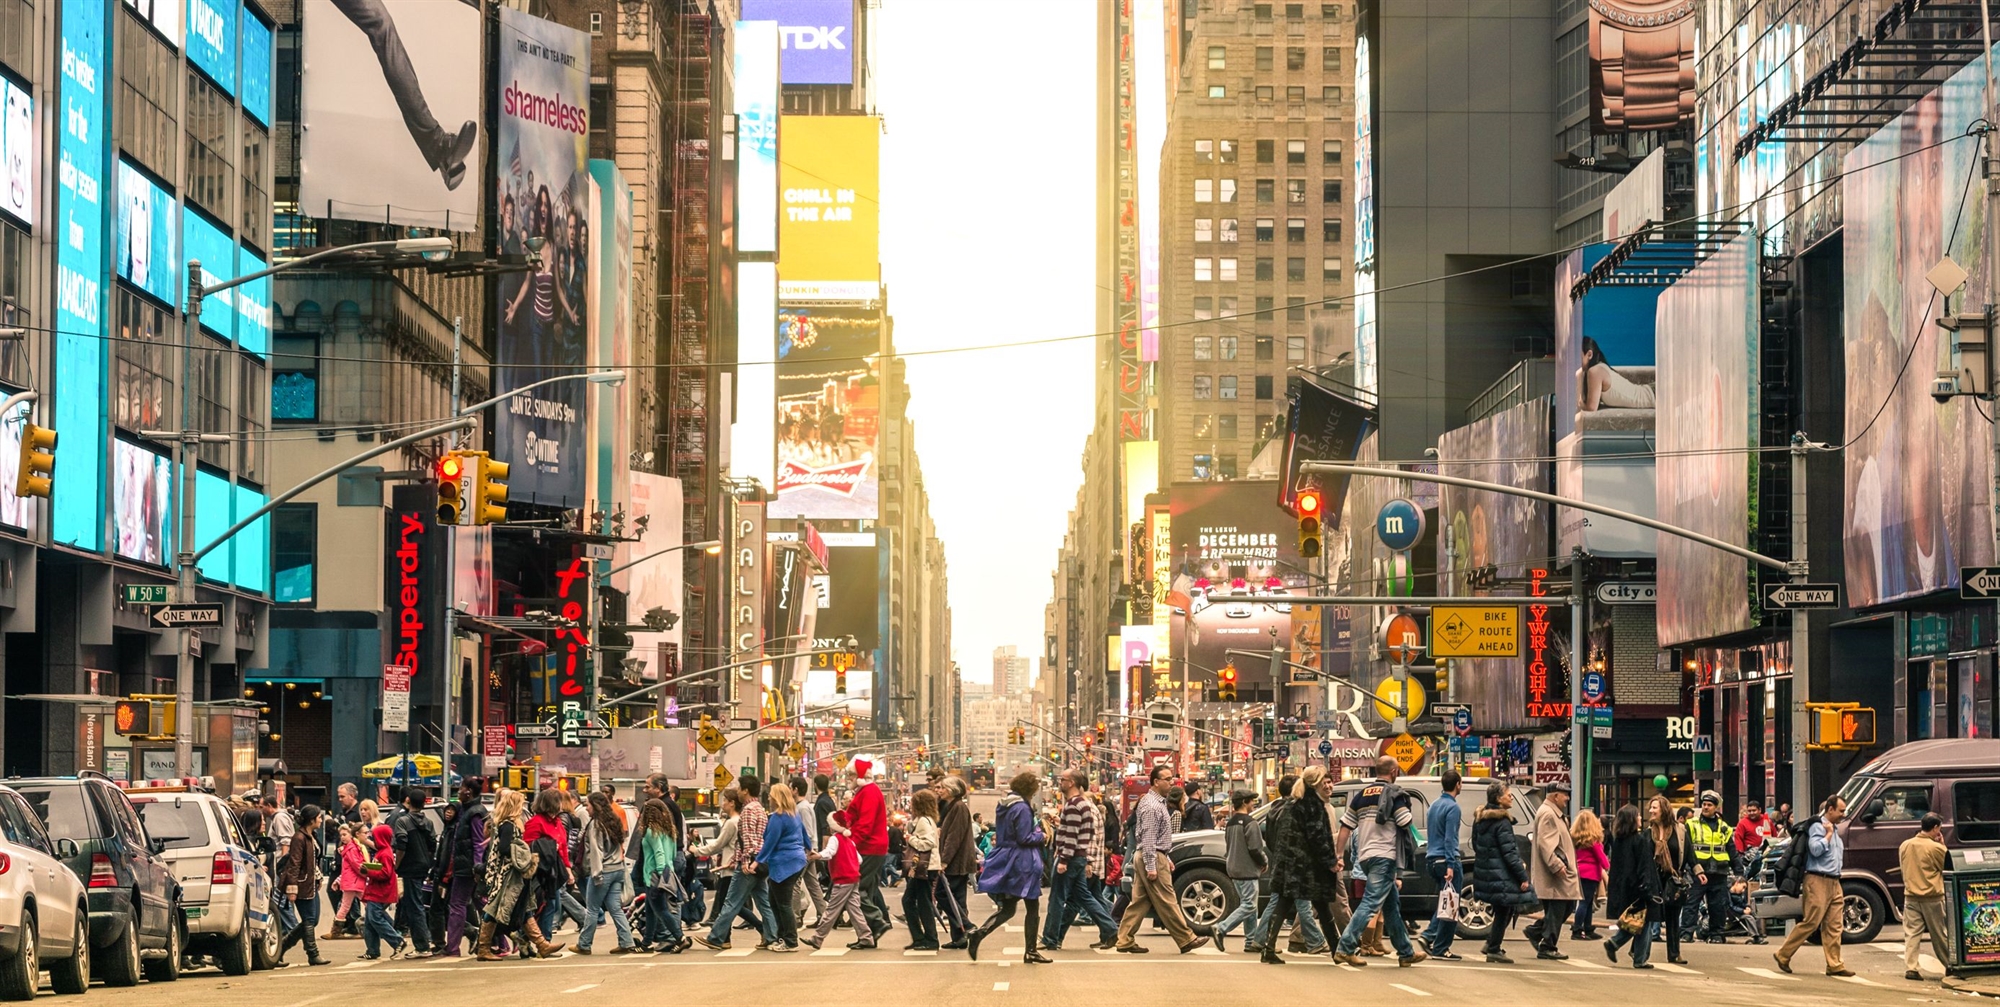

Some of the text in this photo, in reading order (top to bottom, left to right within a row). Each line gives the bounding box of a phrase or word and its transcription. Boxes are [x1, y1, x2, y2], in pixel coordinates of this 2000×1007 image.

[778, 26, 846, 49] TDK
[550, 49, 559, 63] TEA
[560, 52, 576, 69] PARTY
[505, 80, 586, 135] shameless
[784, 188, 855, 203] CHILL IN
[787, 207, 852, 222] THE AIR
[62, 265, 97, 325] BARCLAYS
[510, 395, 576, 423] JAN 12 SUNDAYS 9PM
[777, 467, 867, 486] Budweiser
[1385, 516, 1404, 534] m
[1199, 533, 1277, 547] DECEMBER
[129, 586, 164, 601] W 50 ST
[395, 511, 425, 677] Superdry.
[739, 519, 753, 680] PALACE
[1608, 585, 1656, 599] city o
[1778, 591, 1829, 601] ONE WAY
[163, 611, 214, 621] ONE WAY
[1484, 612, 1507, 621] BIKE
[1479, 627, 1512, 636] ROUTE
[1527, 569, 1549, 702] PLYWRIGHT
[811, 638, 842, 648] ONY
[1478, 642, 1514, 651] AHEAD
[819, 653, 828, 667] 3
[1328, 681, 1377, 740] R
[86, 714, 96, 768] Newsstand
[1308, 748, 1376, 758] RAISSAN
[1535, 773, 1572, 784] PIZZA
